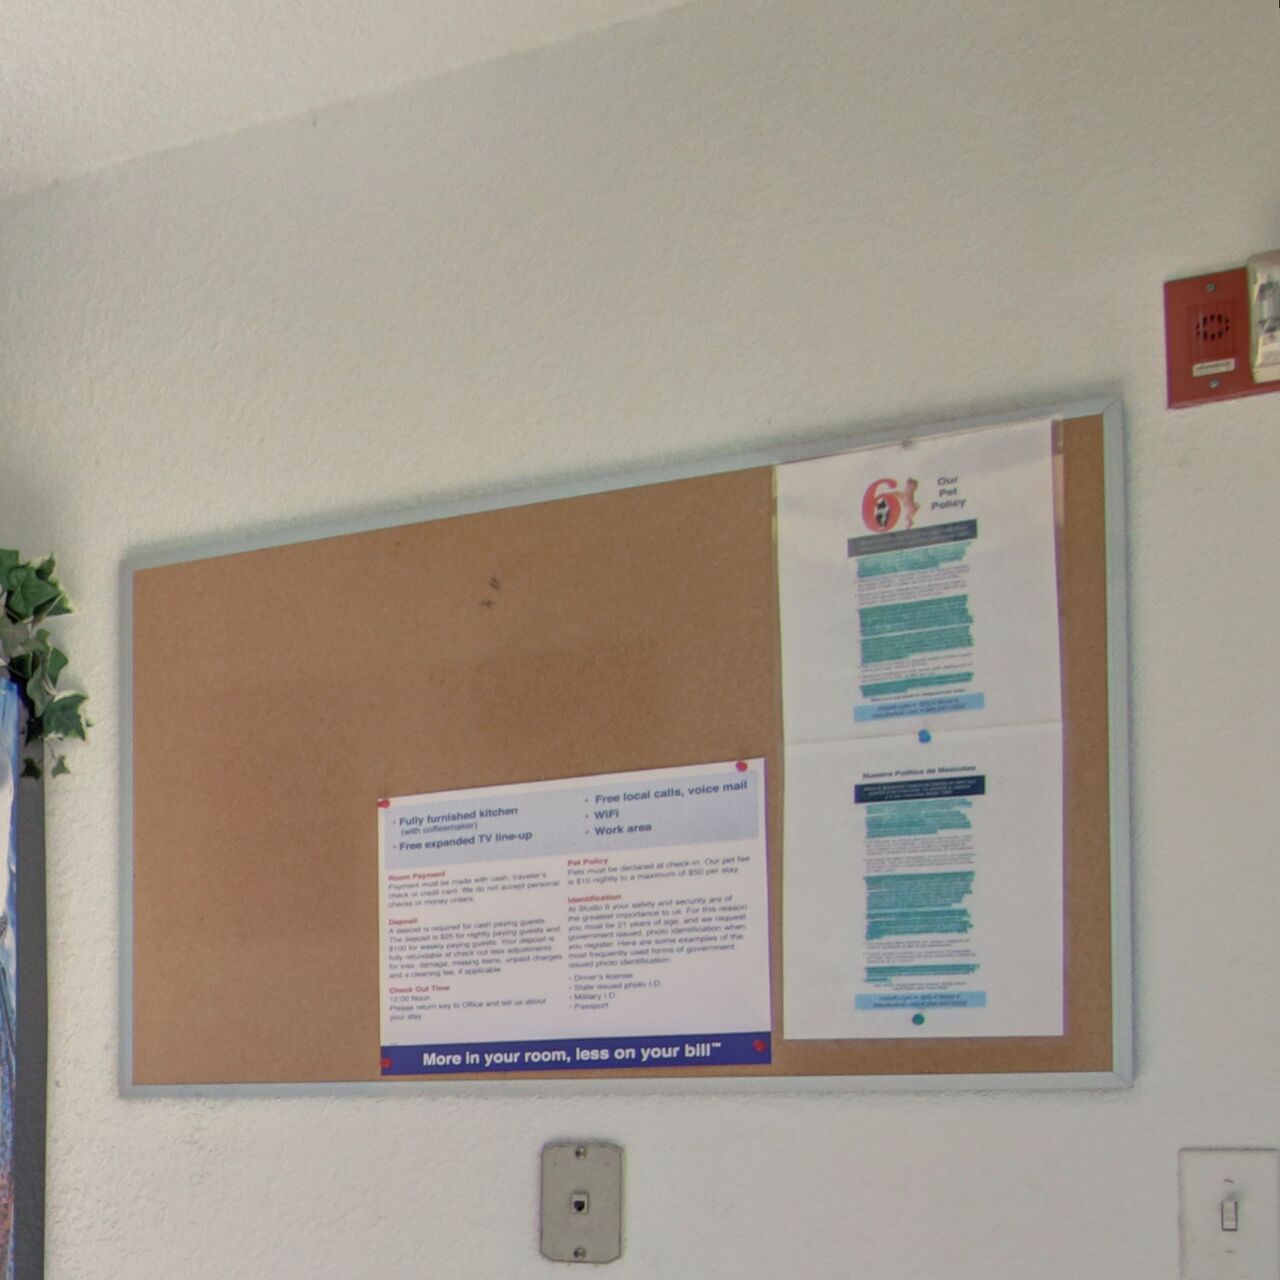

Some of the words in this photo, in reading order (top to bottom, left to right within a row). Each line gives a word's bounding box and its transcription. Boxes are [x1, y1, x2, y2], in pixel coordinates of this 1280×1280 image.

[937, 476, 958, 486] Our
[939, 487, 958, 497] Pet
[931, 498, 967, 511] Policy
[594, 792, 620, 804] Free
[622, 790, 650, 802] local
[653, 787, 683, 799] calls,
[687, 783, 719, 796] voice
[722, 779, 748, 792] mail
[398, 814, 423, 827] Fully
[426, 810, 476, 824] furnished
[478, 805, 518, 819] kitchen
[593, 808, 619, 820] WiFi
[400, 826, 420, 836] (with
[422, 821, 478, 834] coffeemaker)
[594, 824, 624, 836] Work
[626, 823, 652, 834] area
[398, 840, 422, 851] Free
[424, 836, 475, 849] expanded
[478, 833, 492, 843] TV
[494, 830, 532, 843] line-up
[566, 858, 581, 867] Pet
[582, 856, 608, 866] Policy
[566, 867, 584, 876] Pets
[586, 866, 606, 875] must
[619, 862, 654, 872] declared
[703, 856, 720, 866] Our
[721, 856, 735, 865] pet
[736, 854, 751, 863] fee
[387, 873, 411, 882] Room
[411, 870, 446, 881] Payment
[566, 892, 622, 904] Identification
[577, 902, 603, 912] Studio
[612, 902, 629, 910] your
[631, 900, 655, 909] safety
[657, 899, 673, 907] and
[674, 896, 706, 906] security
[708, 895, 722, 904] are
[567, 914, 580, 922] the
[581, 913, 613, 922] greatest
[615, 909, 660, 919] importance
[685, 905, 700, 915] For
[701, 905, 717, 913] this
[718, 903, 748, 912] reason
[387, 917, 418, 926] Deposit
[388, 985, 413, 994] Check
[414, 984, 429, 993] Out
[431, 983, 450, 992] Time
[422, 1051, 461, 1066] More
[465, 1050, 479, 1064] in
[484, 1051, 519, 1065] your
[524, 1049, 570, 1062] room,
[575, 1047, 609, 1060] less
[614, 1047, 635, 1059] on
[640, 1046, 679, 1060] your
